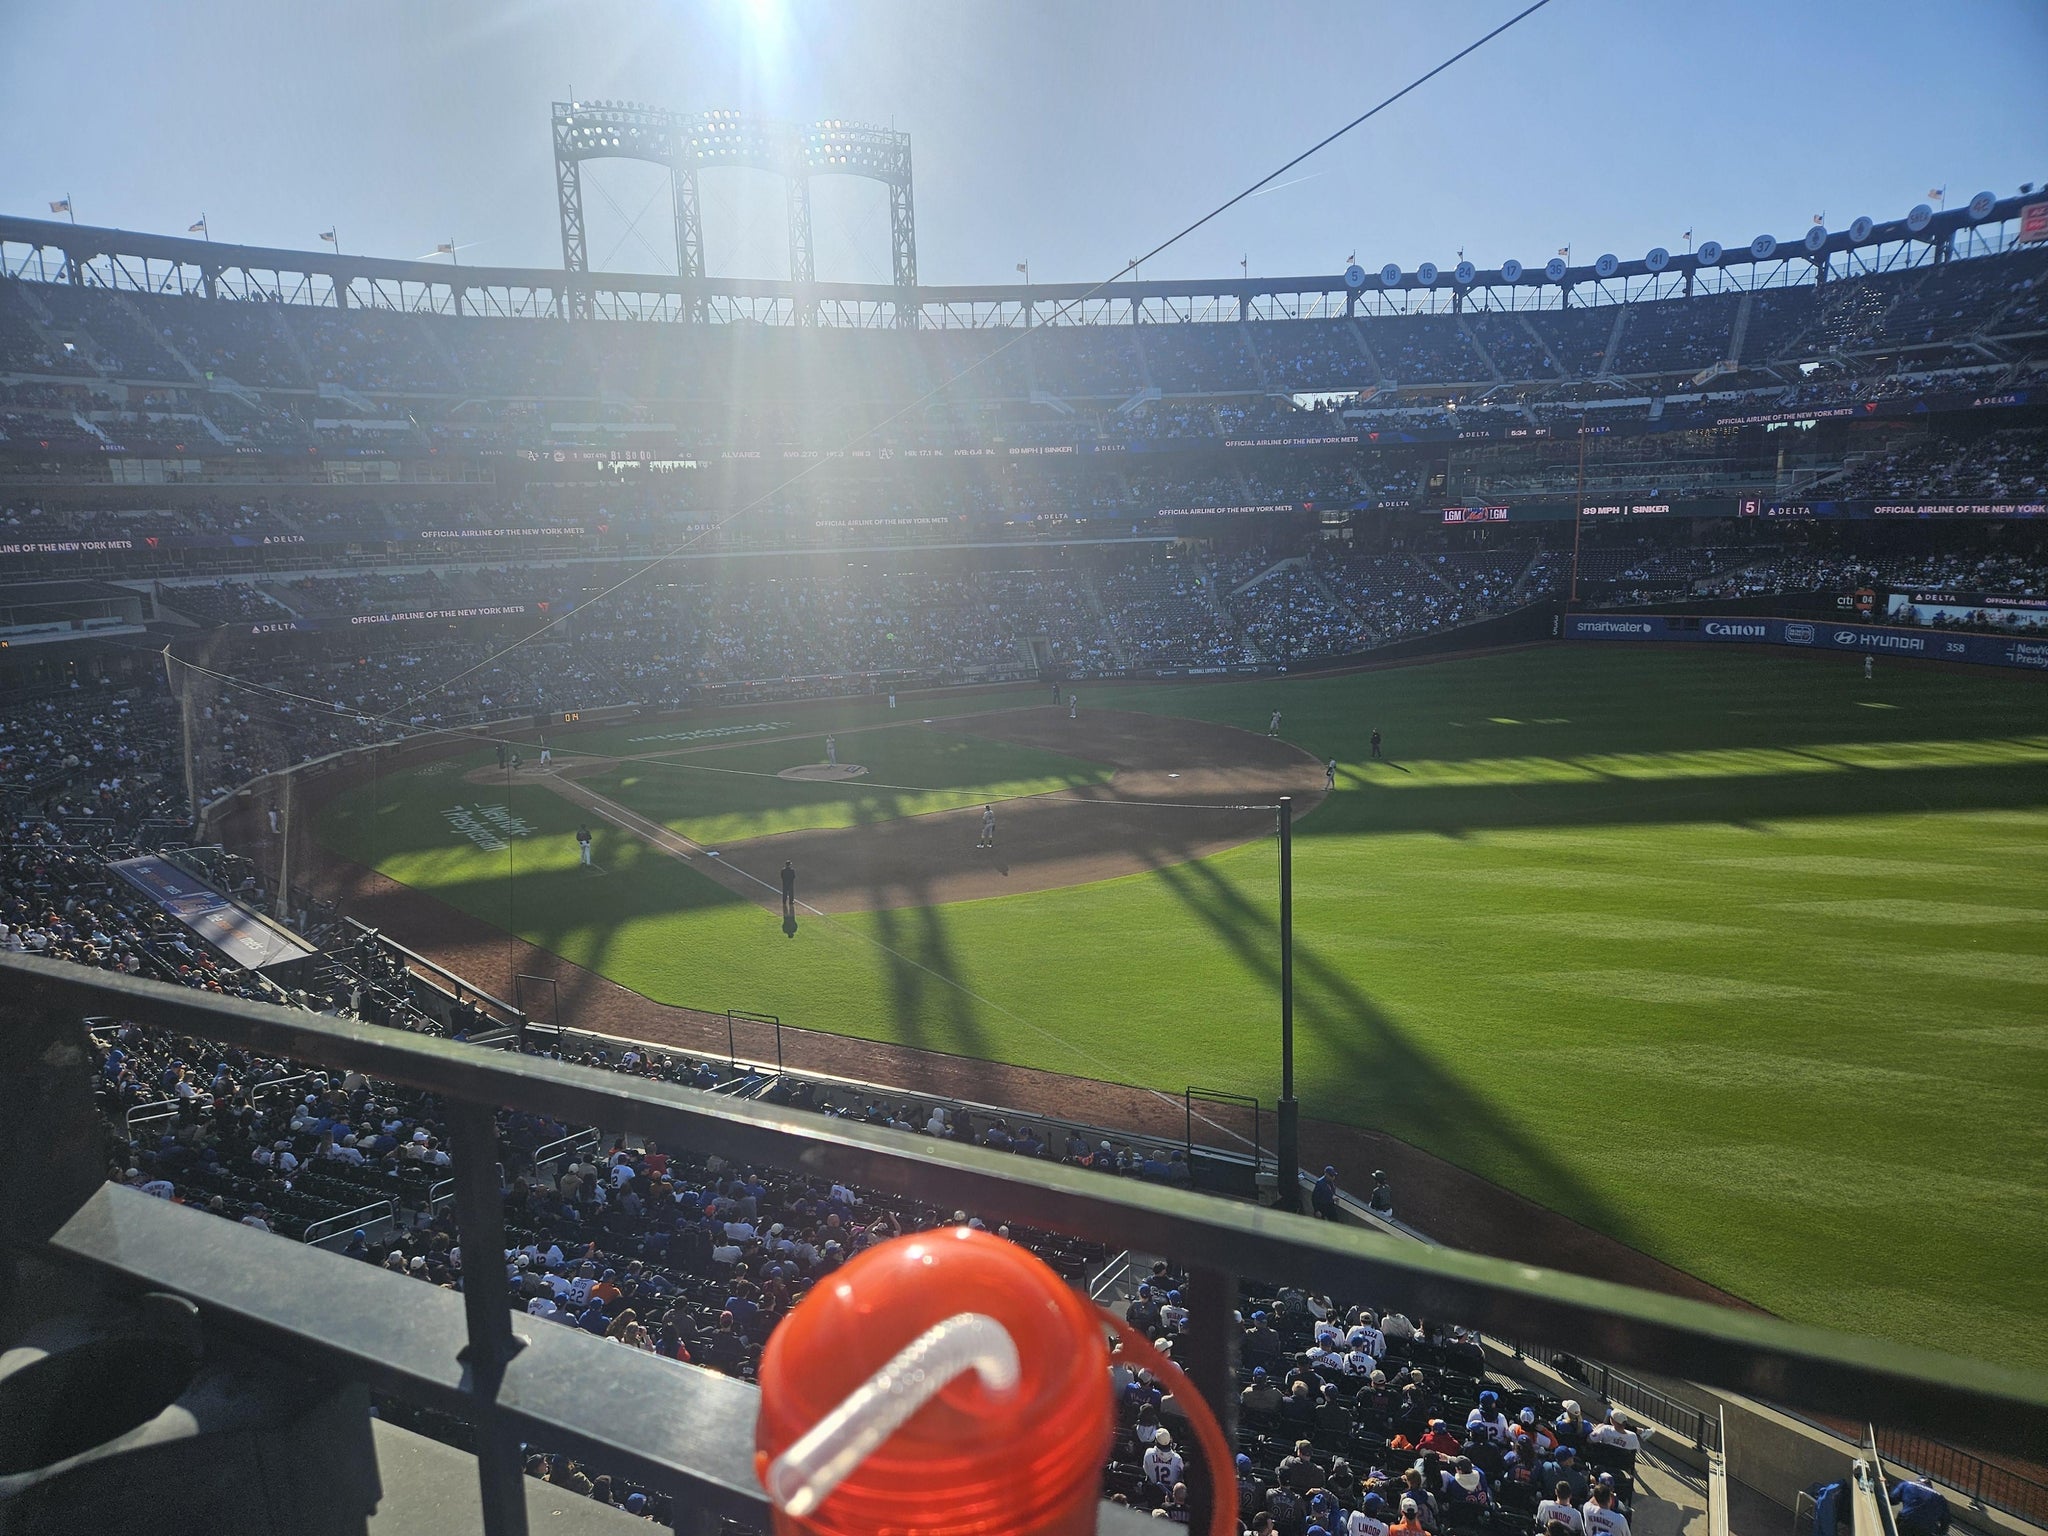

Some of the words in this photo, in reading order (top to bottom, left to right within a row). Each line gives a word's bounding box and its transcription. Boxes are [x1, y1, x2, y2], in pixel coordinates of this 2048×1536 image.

[1973, 199, 1990, 212] 42
[1910, 212, 1929, 225] SHEA
[1757, 241, 1770, 252] 37
[1704, 248, 1715, 259] 14
[1652, 254, 1663, 265] 41
[1550, 265, 1562, 275] 36
[1602, 260, 1612, 271] 31
[1351, 271, 1358, 281] 5
[1386, 270, 1396, 280] 18
[1422, 269, 1432, 279] 16
[1458, 267, 1471, 278] 24
[1507, 266, 1517, 276] 17
[1984, 395, 2015, 404] DELTA
[1717, 418, 1744, 426] OFFICIAL
[1745, 416, 1771, 424] AIRLINE
[1225, 439, 1255, 447] OFFICIAL
[1044, 446, 1072, 454] SINKER
[1158, 508, 1189, 516] OFFICIAL
[1190, 507, 1216, 515] AIRLINE
[1582, 507, 1597, 515] 89
[1597, 507, 1620, 515] MPH
[1632, 505, 1670, 514] SINKER
[1746, 502, 1755, 514] 5
[1778, 507, 1810, 515] DELTA
[1874, 506, 1915, 514] OFFICIAL
[1972, 505, 1991, 513] THE
[1992, 505, 2016, 513] NEW
[2017, 504, 2046, 513] YORK
[1445, 510, 1462, 521] LGM
[1489, 509, 1507, 519] LGM
[421, 530, 459, 538] OFFICIAL
[461, 529, 493, 537] AIRLINE
[506, 528, 521, 536] THE
[540, 527, 562, 535] YORK
[273, 535, 305, 543] DELTA
[22, 544, 36, 552] OF
[37, 543, 57, 551] THE
[58, 542, 80, 551] NEW
[81, 541, 107, 550] YORK
[108, 540, 132, 549] METS
[1837, 596, 1853, 605] citi
[1862, 595, 1873, 604] 04
[1925, 594, 1956, 602] DELTA
[1985, 597, 2017, 605] OFFICIAL
[351, 615, 390, 625] OFFICIAL
[391, 612, 425, 622] AIRLINE
[426, 611, 437, 619] OF
[438, 610, 457, 618] THE
[457, 608, 477, 617] NEW
[478, 607, 501, 616] YORK
[502, 605, 524, 614] METS
[262, 623, 297, 632] DELTA
[1577, 622, 1642, 633] smartwater
[1705, 622, 1765, 636] Canon
[1860, 634, 1924, 650] HYUNDAI
[1946, 642, 1965, 653] 358
[574, 1280, 587, 1289] SOTO
[570, 1288, 584, 1304] 22
[1353, 1355, 1365, 1363] SOTO
[1154, 1465, 1171, 1484] 12
[1548, 1510, 1572, 1525] LINDOR
[1358, 1522, 1381, 1536] LINDOR
